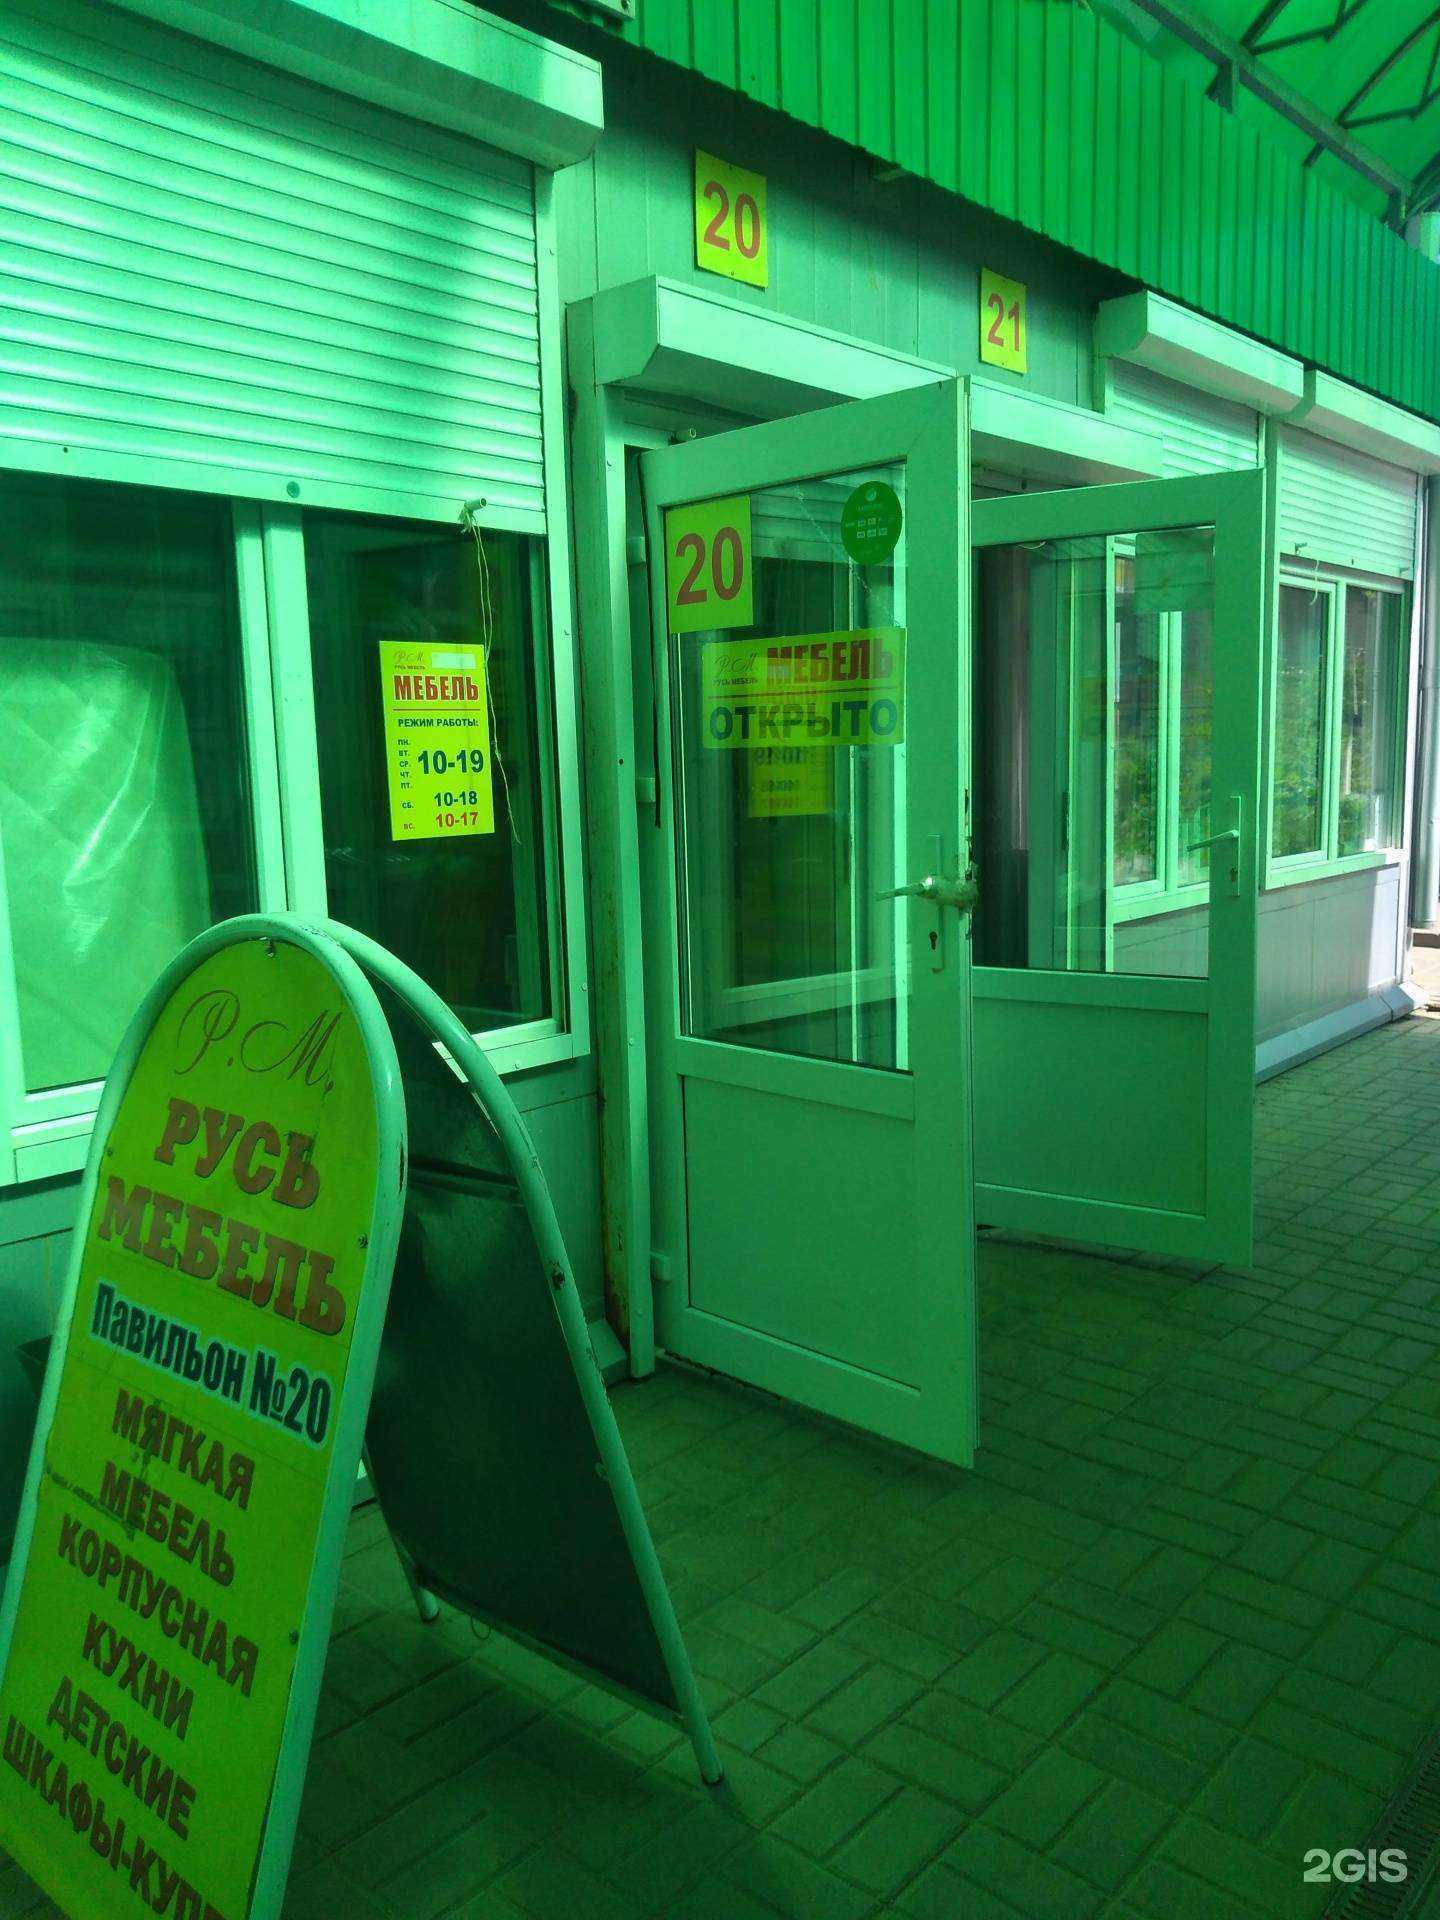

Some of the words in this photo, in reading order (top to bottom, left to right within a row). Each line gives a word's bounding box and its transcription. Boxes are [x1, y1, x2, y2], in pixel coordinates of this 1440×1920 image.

[703, 181, 760, 259] 20
[987, 293, 1020, 352] 21
[675, 527, 744, 605] 20
[394, 675, 478, 700] МЕБЕЛЬ
[767, 638, 893, 687] МЕБЕЛЬ
[398, 718, 433, 727] РЕЖИМ
[437, 718, 479, 727] РАБОТЫ:
[710, 699, 897, 740] ОТКРЫТО
[418, 750, 484, 774] 10-19
[434, 791, 478, 806] 10-18
[436, 812, 478, 828] 10-17
[154, 1097, 320, 1208] РУСЬ
[97, 1176, 345, 1336] МЕБЕЛЬ
[92, 1282, 247, 1404] Павильон
[249, 1350, 332, 1443] №20
[112, 1387, 255, 1510] МЯГКАЯ
[100, 1460, 234, 1587] МЕБЕЛЬ
[58, 1512, 258, 1698] КОРПУСНАЯ
[82, 1611, 194, 1740] КУХНИ
[47, 1675, 196, 1841] ДЕТСКИЕ
[3, 1713, 226, 1919] ШКАФЫ-КУП
